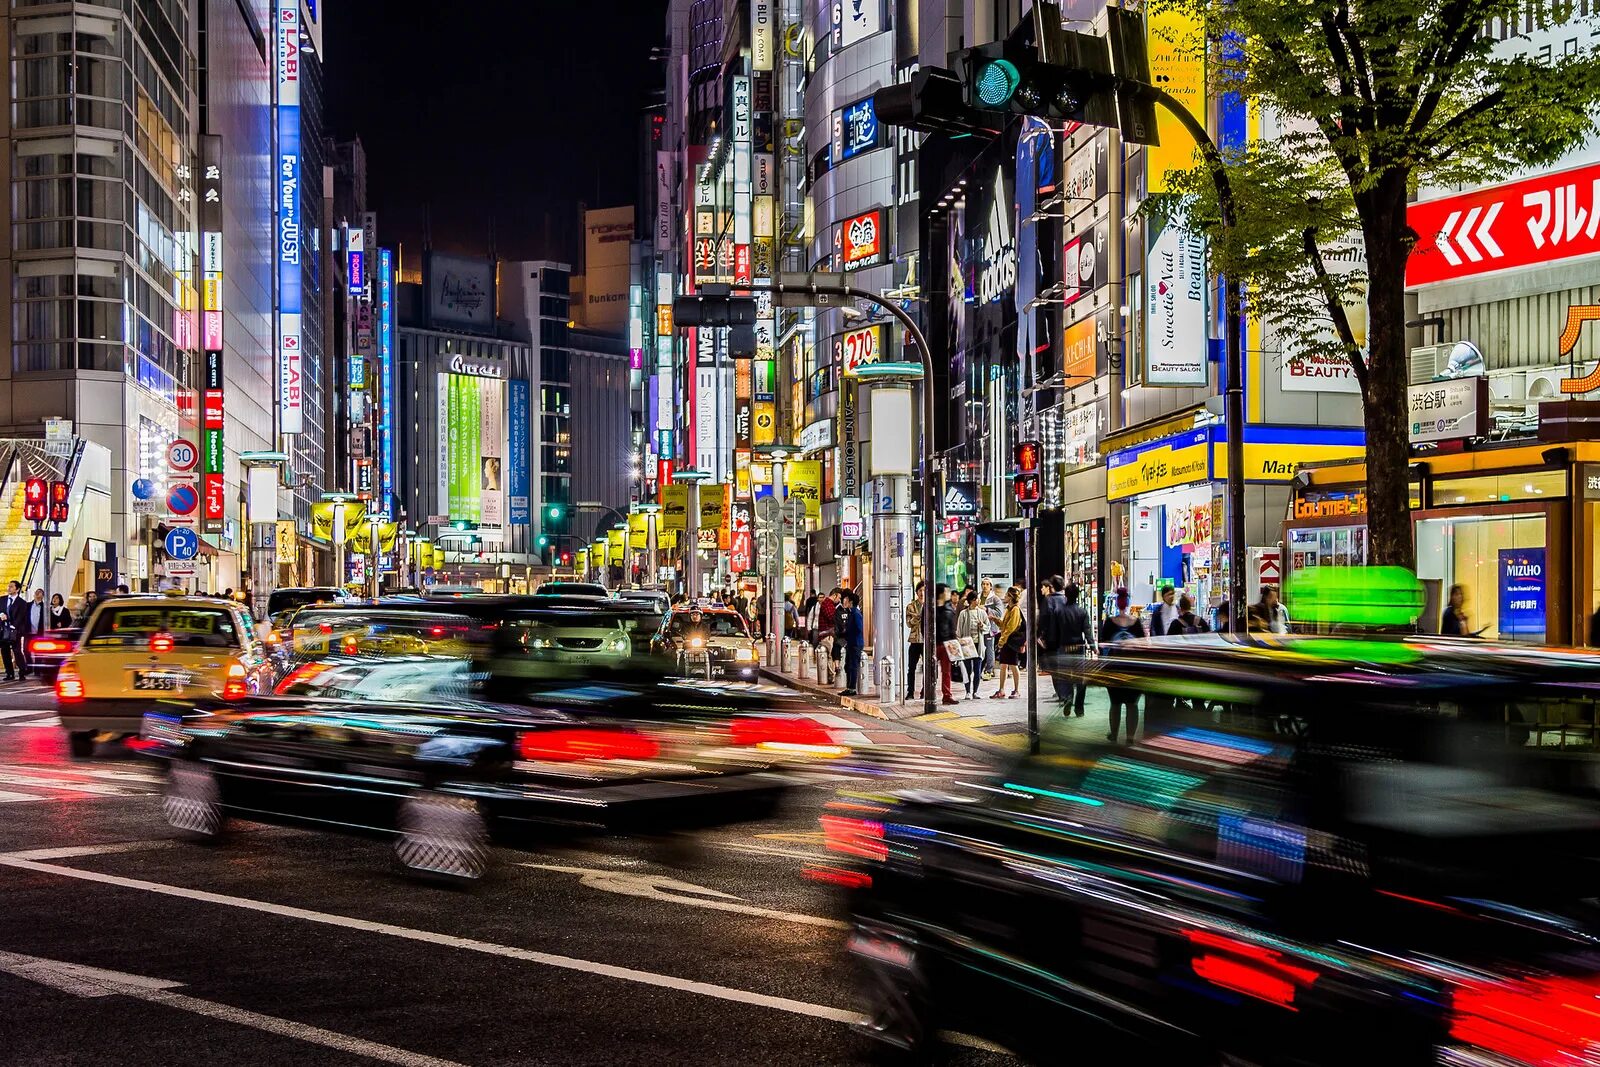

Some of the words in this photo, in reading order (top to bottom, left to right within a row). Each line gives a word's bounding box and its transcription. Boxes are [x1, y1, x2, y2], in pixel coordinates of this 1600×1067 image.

[757, 4, 768, 24] BLD
[286, 29, 297, 81] LABI
[282, 155, 296, 177] For
[283, 178, 296, 209] Your
[282, 217, 298, 264] JUST
[661, 219, 669, 239] DOT
[352, 254, 360, 284] PROMISE
[981, 249, 1015, 304] adidas
[1161, 251, 1174, 287] Nail
[589, 294, 627, 304] Bunkam
[1161, 293, 1174, 349] Sweetie
[846, 330, 873, 369] 270
[289, 355, 299, 407] LABI
[1290, 359, 1351, 377] BEAUTY
[1412, 390, 1446, 411] 渋谷駅
[700, 391, 712, 442] SoftBank
[845, 401, 855, 435] SAINT
[173, 448, 191, 463] 30
[845, 440, 855, 475] LOUIS
[882, 497, 892, 509] 2
[173, 536, 186, 556] P
[182, 547, 192, 556] 40
[1507, 564, 1541, 577] MIZUHO
